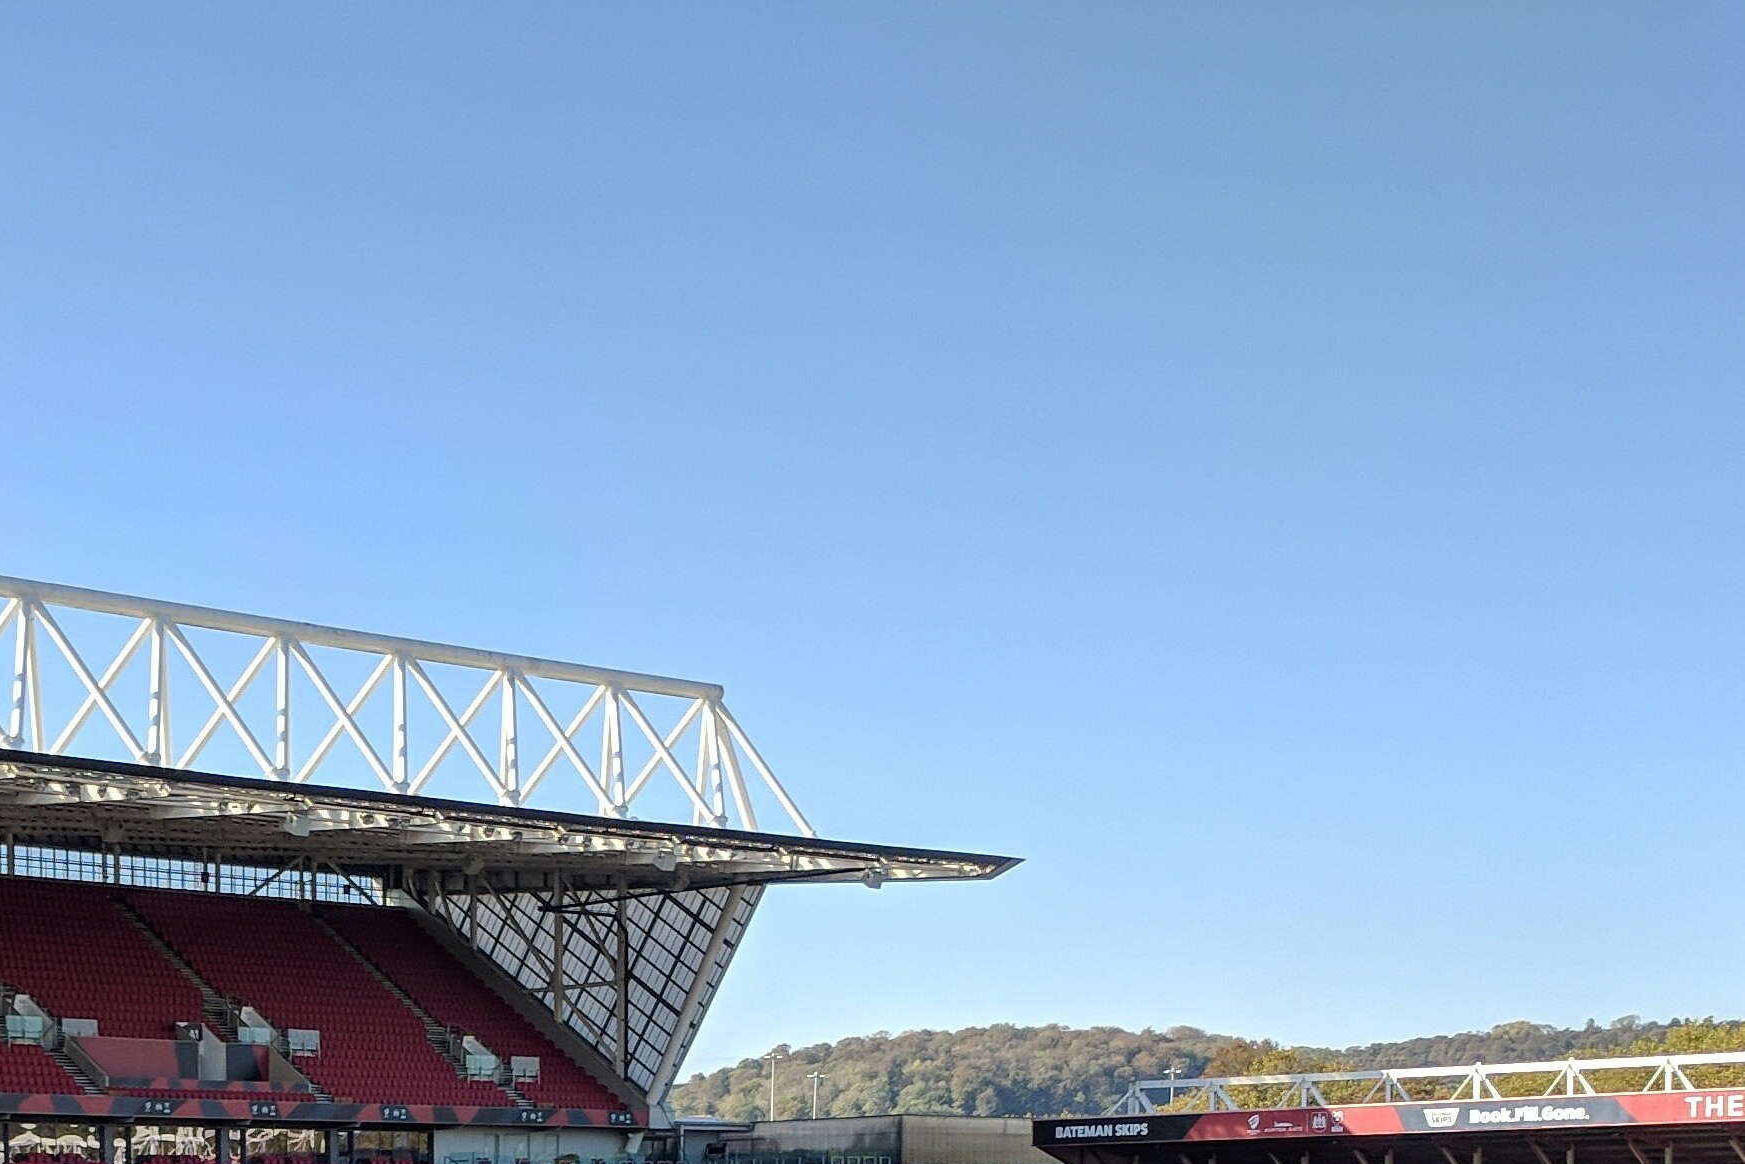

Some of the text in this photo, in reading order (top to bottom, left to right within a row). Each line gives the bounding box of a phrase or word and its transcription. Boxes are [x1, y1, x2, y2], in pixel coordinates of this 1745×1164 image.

[1684, 1094, 1745, 1118] THE
[1055, 1122, 1149, 1138] BATEMAN SKIPS
